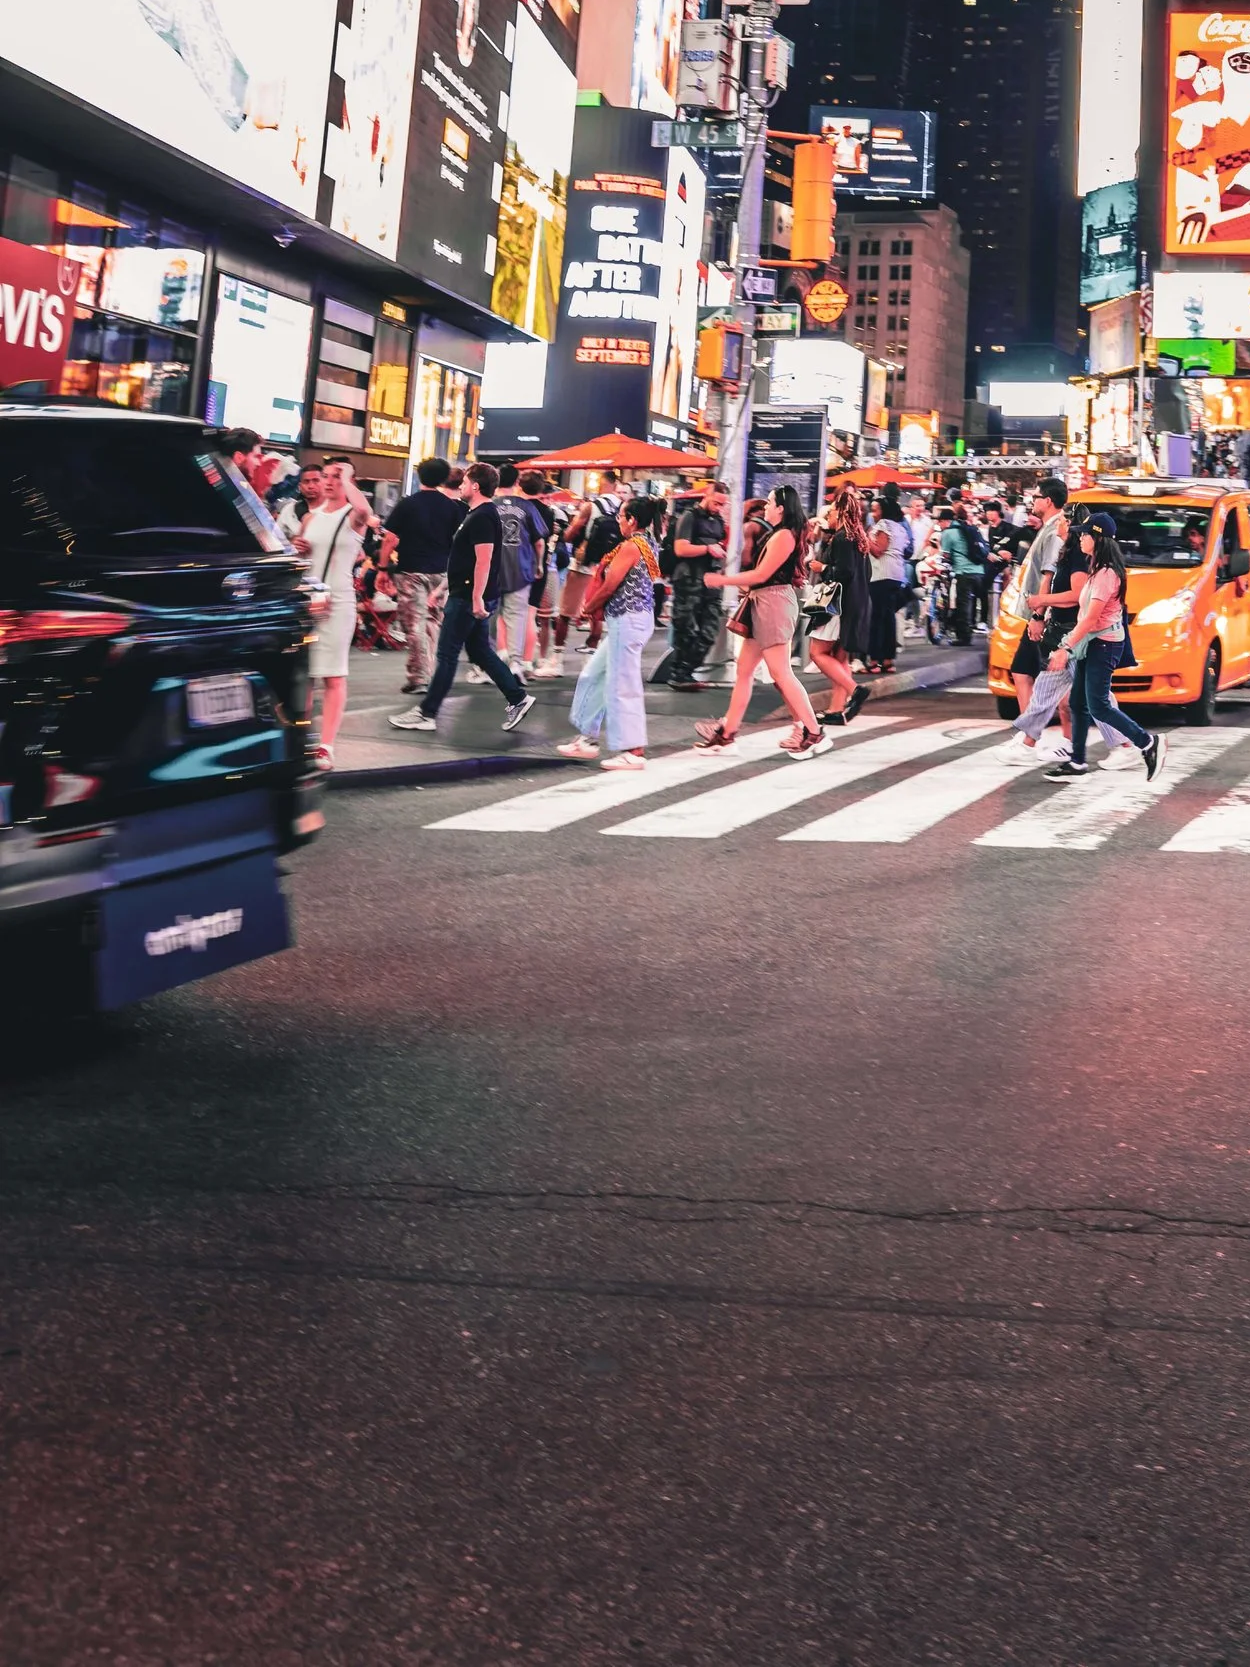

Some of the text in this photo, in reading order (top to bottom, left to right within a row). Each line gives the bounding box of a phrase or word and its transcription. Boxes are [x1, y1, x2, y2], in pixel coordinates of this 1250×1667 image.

[674, 124, 691, 144] W
[697, 124, 720, 144] 45
[0, 284, 66, 353] VI'S
